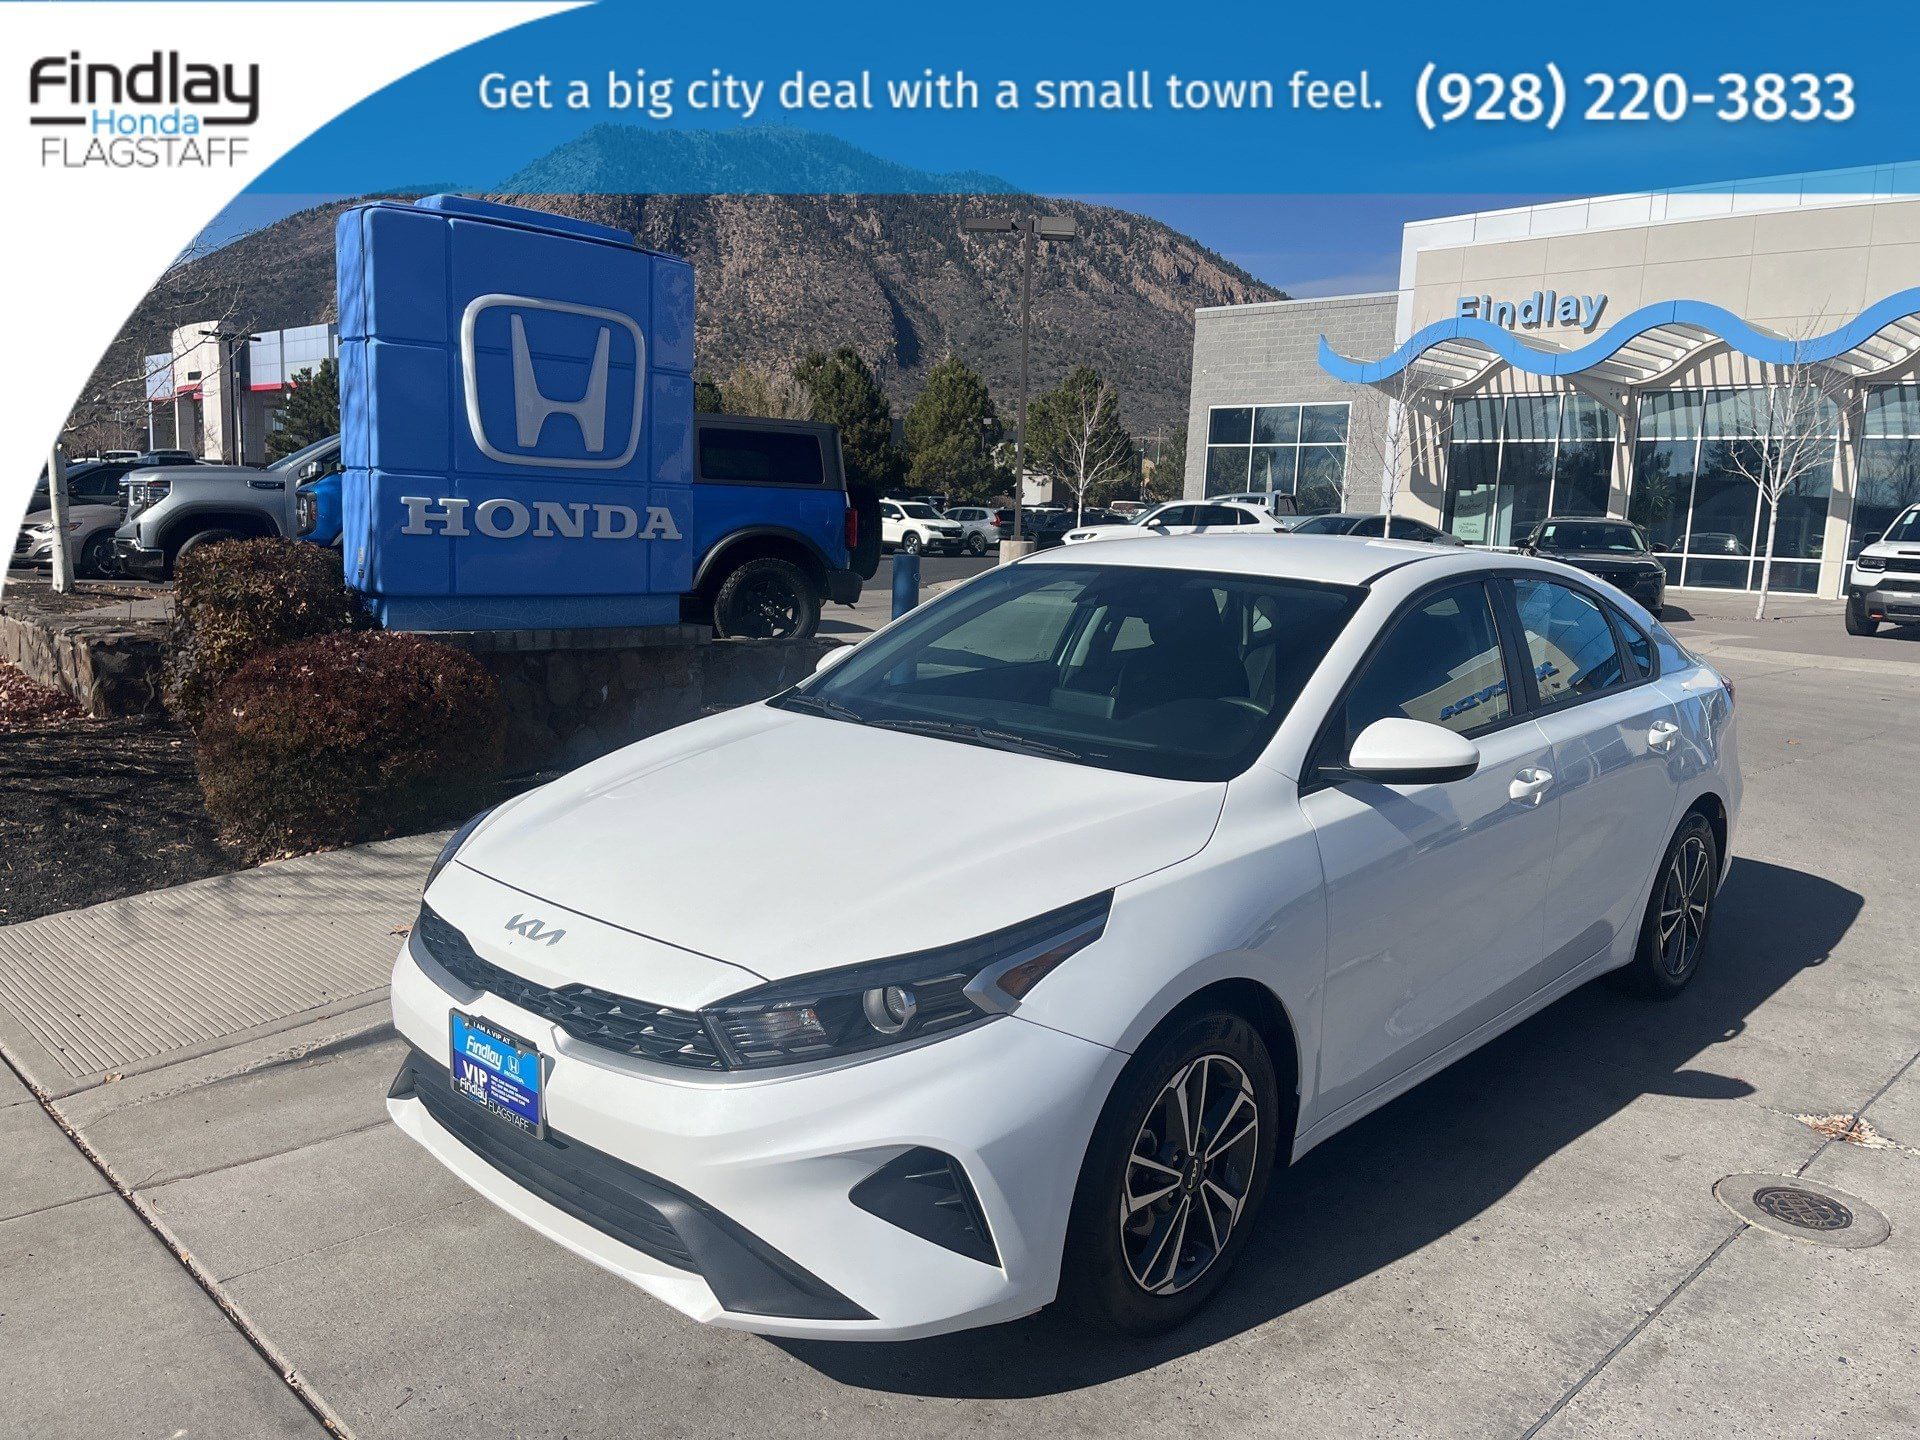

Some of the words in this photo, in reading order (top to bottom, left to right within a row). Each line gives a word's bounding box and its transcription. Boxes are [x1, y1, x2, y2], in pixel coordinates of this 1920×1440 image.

[1457, 290, 1608, 335] Findlay
[400, 496, 683, 540] HONDA
[491, 1030, 502, 1040] VIP
[466, 1034, 503, 1071] Findlay
[462, 1059, 488, 1088] VIP
[460, 1077, 488, 1106] Findlay
[488, 1099, 530, 1131] FLAGSTAFF
